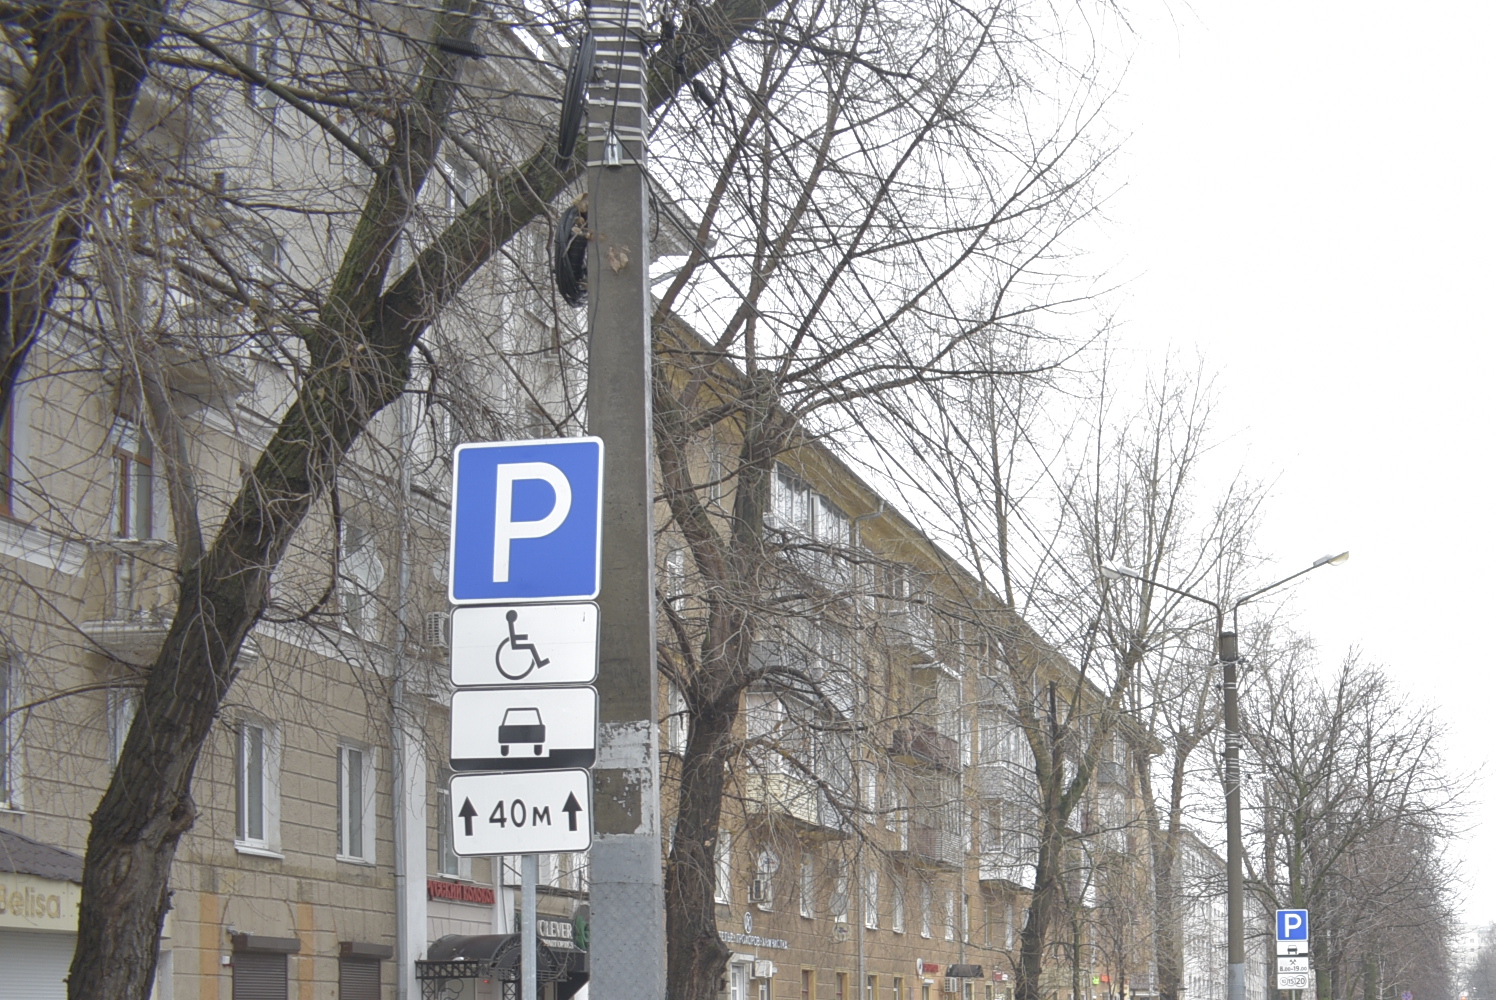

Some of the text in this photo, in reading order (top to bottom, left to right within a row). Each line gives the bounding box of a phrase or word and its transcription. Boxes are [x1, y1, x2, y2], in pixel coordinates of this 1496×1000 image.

[493, 461, 572, 583] P
[537, 919, 573, 939] CLEVER
[1284, 913, 1302, 938] P
[1296, 977, 1306, 985] 20
